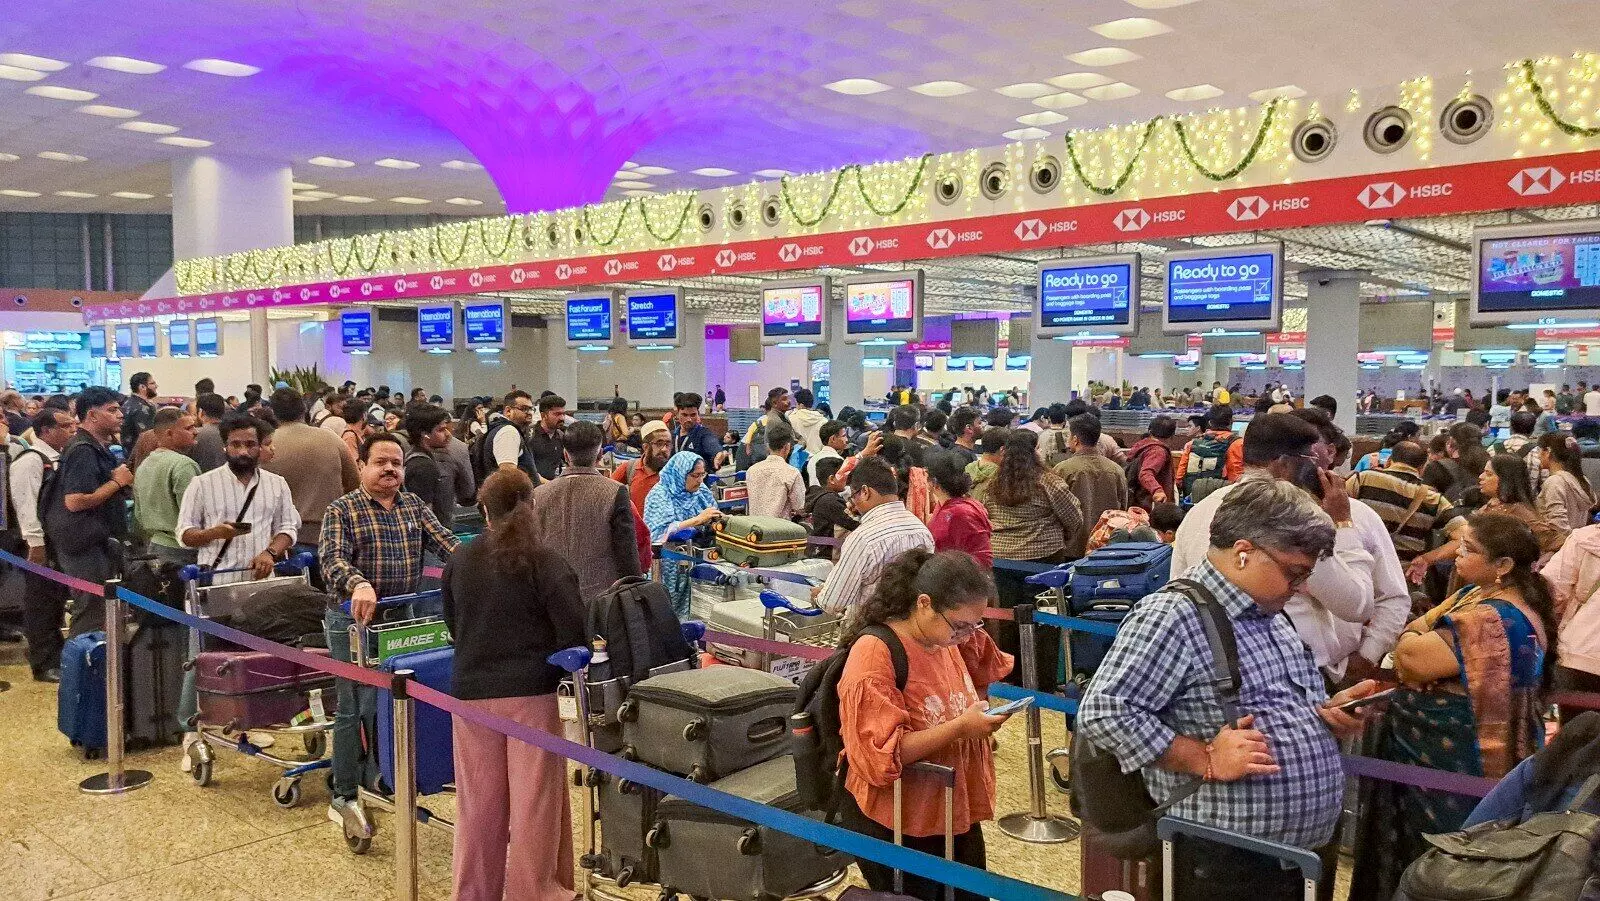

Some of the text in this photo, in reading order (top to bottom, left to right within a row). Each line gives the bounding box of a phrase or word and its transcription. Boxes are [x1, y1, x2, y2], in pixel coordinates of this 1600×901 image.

[1410, 183, 1453, 199] HSBC
[1273, 197, 1310, 211] HSBC
[1153, 210, 1186, 223] HSBC
[1049, 220, 1078, 233] HSBC
[957, 230, 983, 242] HSBC
[876, 238, 899, 249] HSBC
[1492, 241, 1508, 249] NOT
[1511, 239, 1549, 248] CLEARED
[737, 251, 757, 261] HSBC
[803, 245, 824, 256] HSBC
[622, 261, 639, 269] HSBC
[678, 257, 695, 265] HSBC
[572, 266, 587, 275] HSBC
[1173, 263, 1259, 281] Ready to go
[1045, 273, 1118, 290] Ready to go
[1531, 289, 1564, 297] DOMESTIC
[630, 301, 654, 310] Stretch
[387, 633, 435, 650] WAAREE
